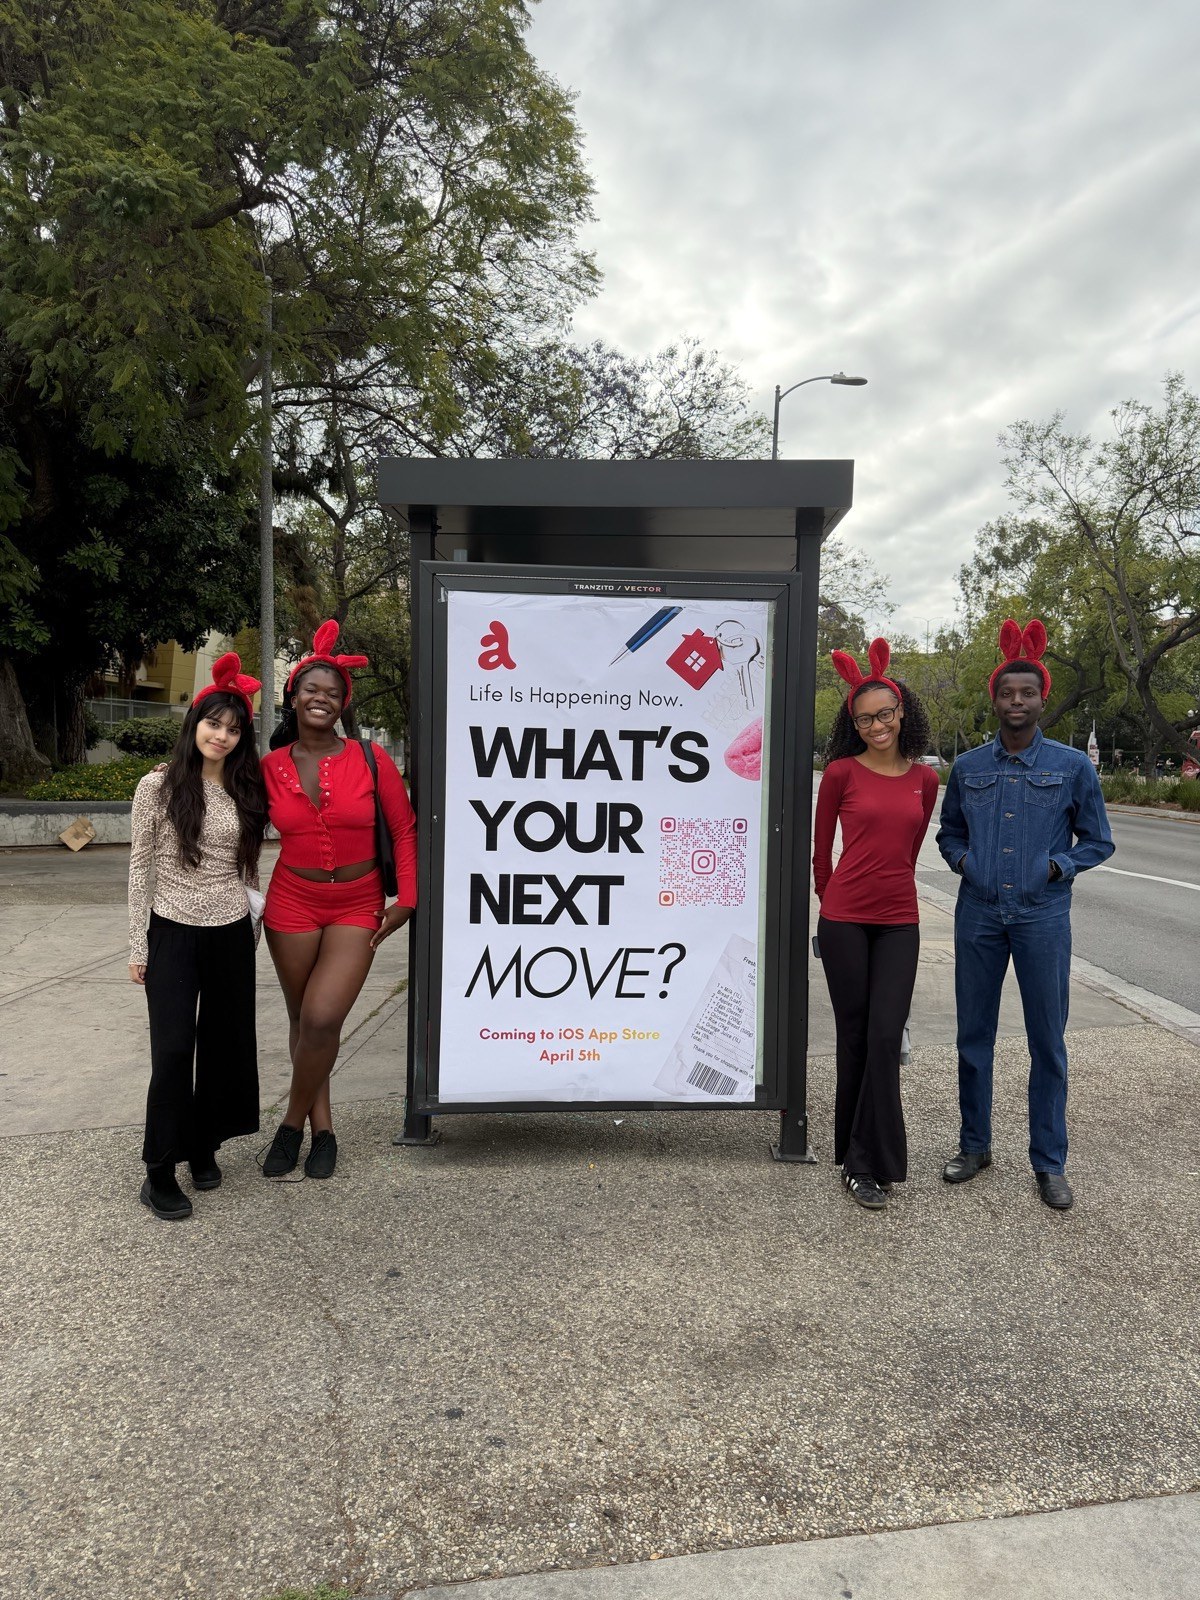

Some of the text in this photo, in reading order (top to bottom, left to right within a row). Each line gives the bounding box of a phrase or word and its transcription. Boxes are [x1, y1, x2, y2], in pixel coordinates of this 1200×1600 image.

[470, 684, 683, 710] Life Is Happening Now.
[469, 726, 710, 783] WHAT'S
[468, 800, 644, 853] YOUR
[470, 873, 625, 925] NEXT
[464, 943, 686, 1000] MOVE?
[479, 1028, 660, 1043] Coming to iOS App Store
[539, 1049, 600, 1065] April 5th
[693, 1044, 705, 1053] Thank
[720, 1059, 739, 1071] shopping
